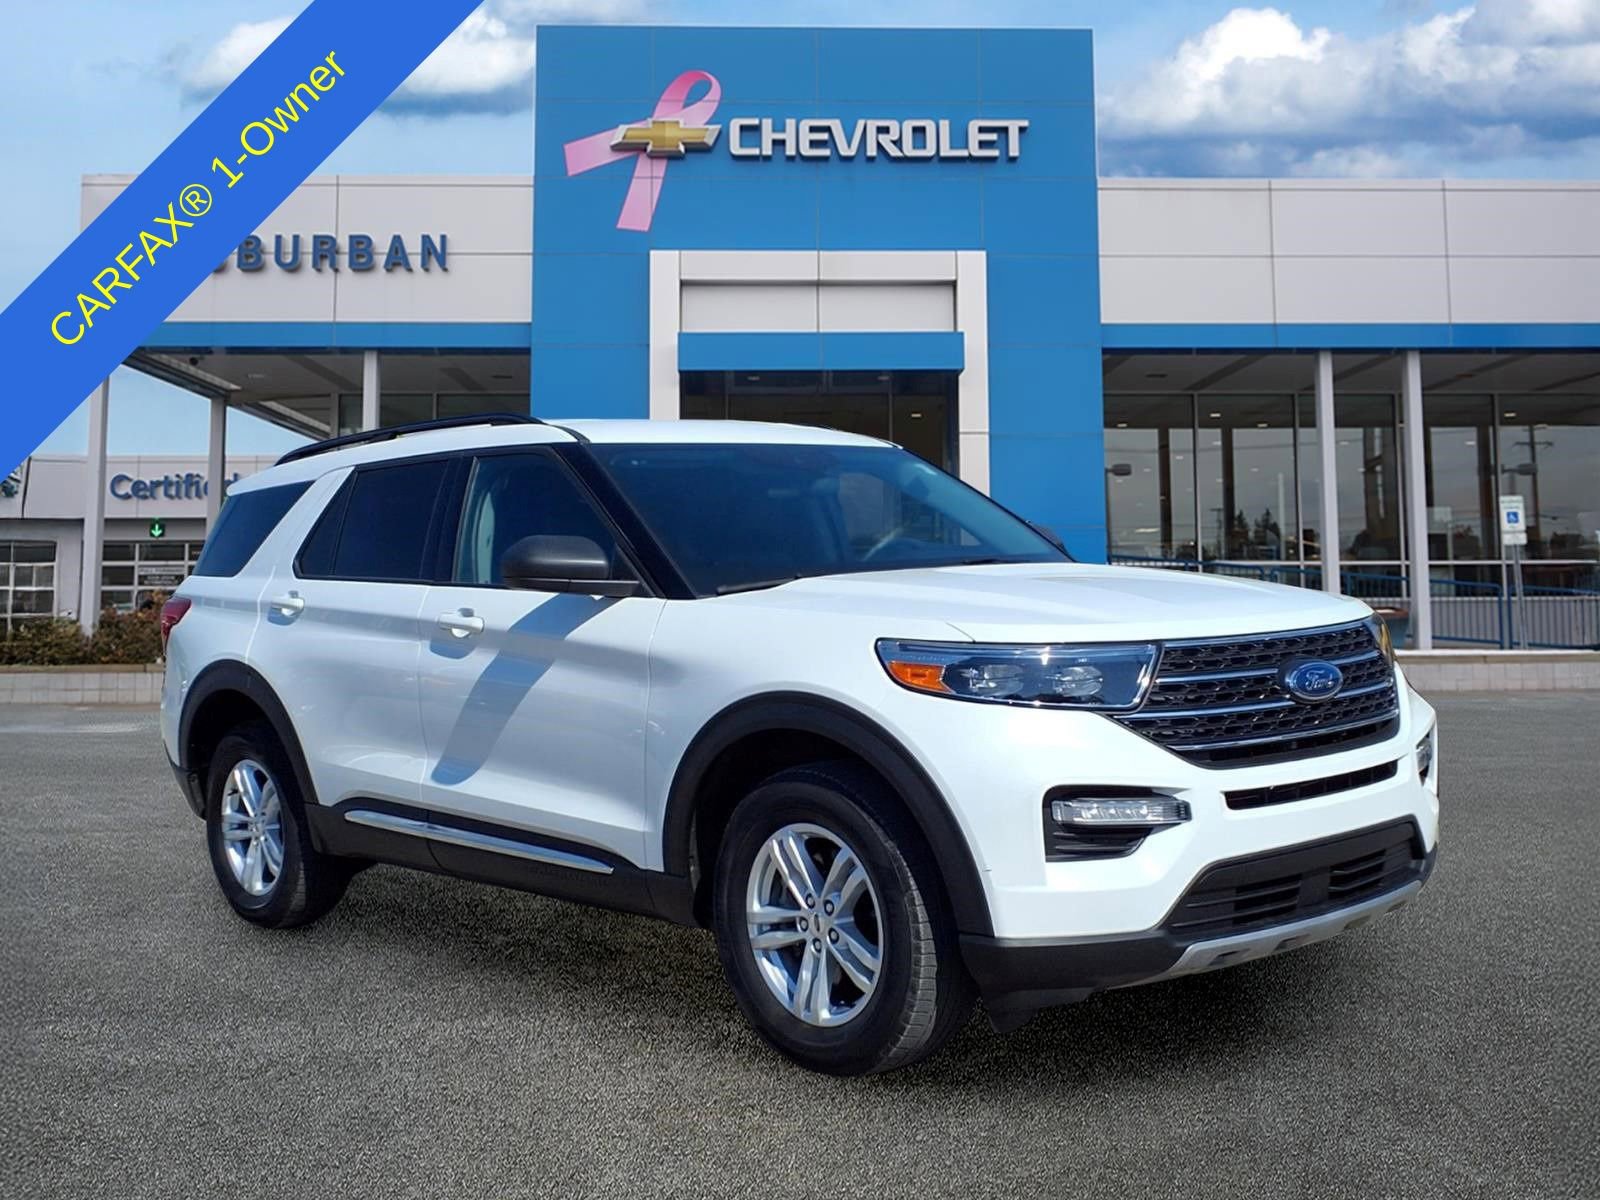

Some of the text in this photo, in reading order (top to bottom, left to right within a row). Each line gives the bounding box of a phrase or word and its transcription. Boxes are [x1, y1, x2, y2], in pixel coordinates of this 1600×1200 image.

[729, 118, 1029, 160] CHEVROLET
[213, 233, 449, 272] BURBAN
[109, 472, 241, 501] Certifi
